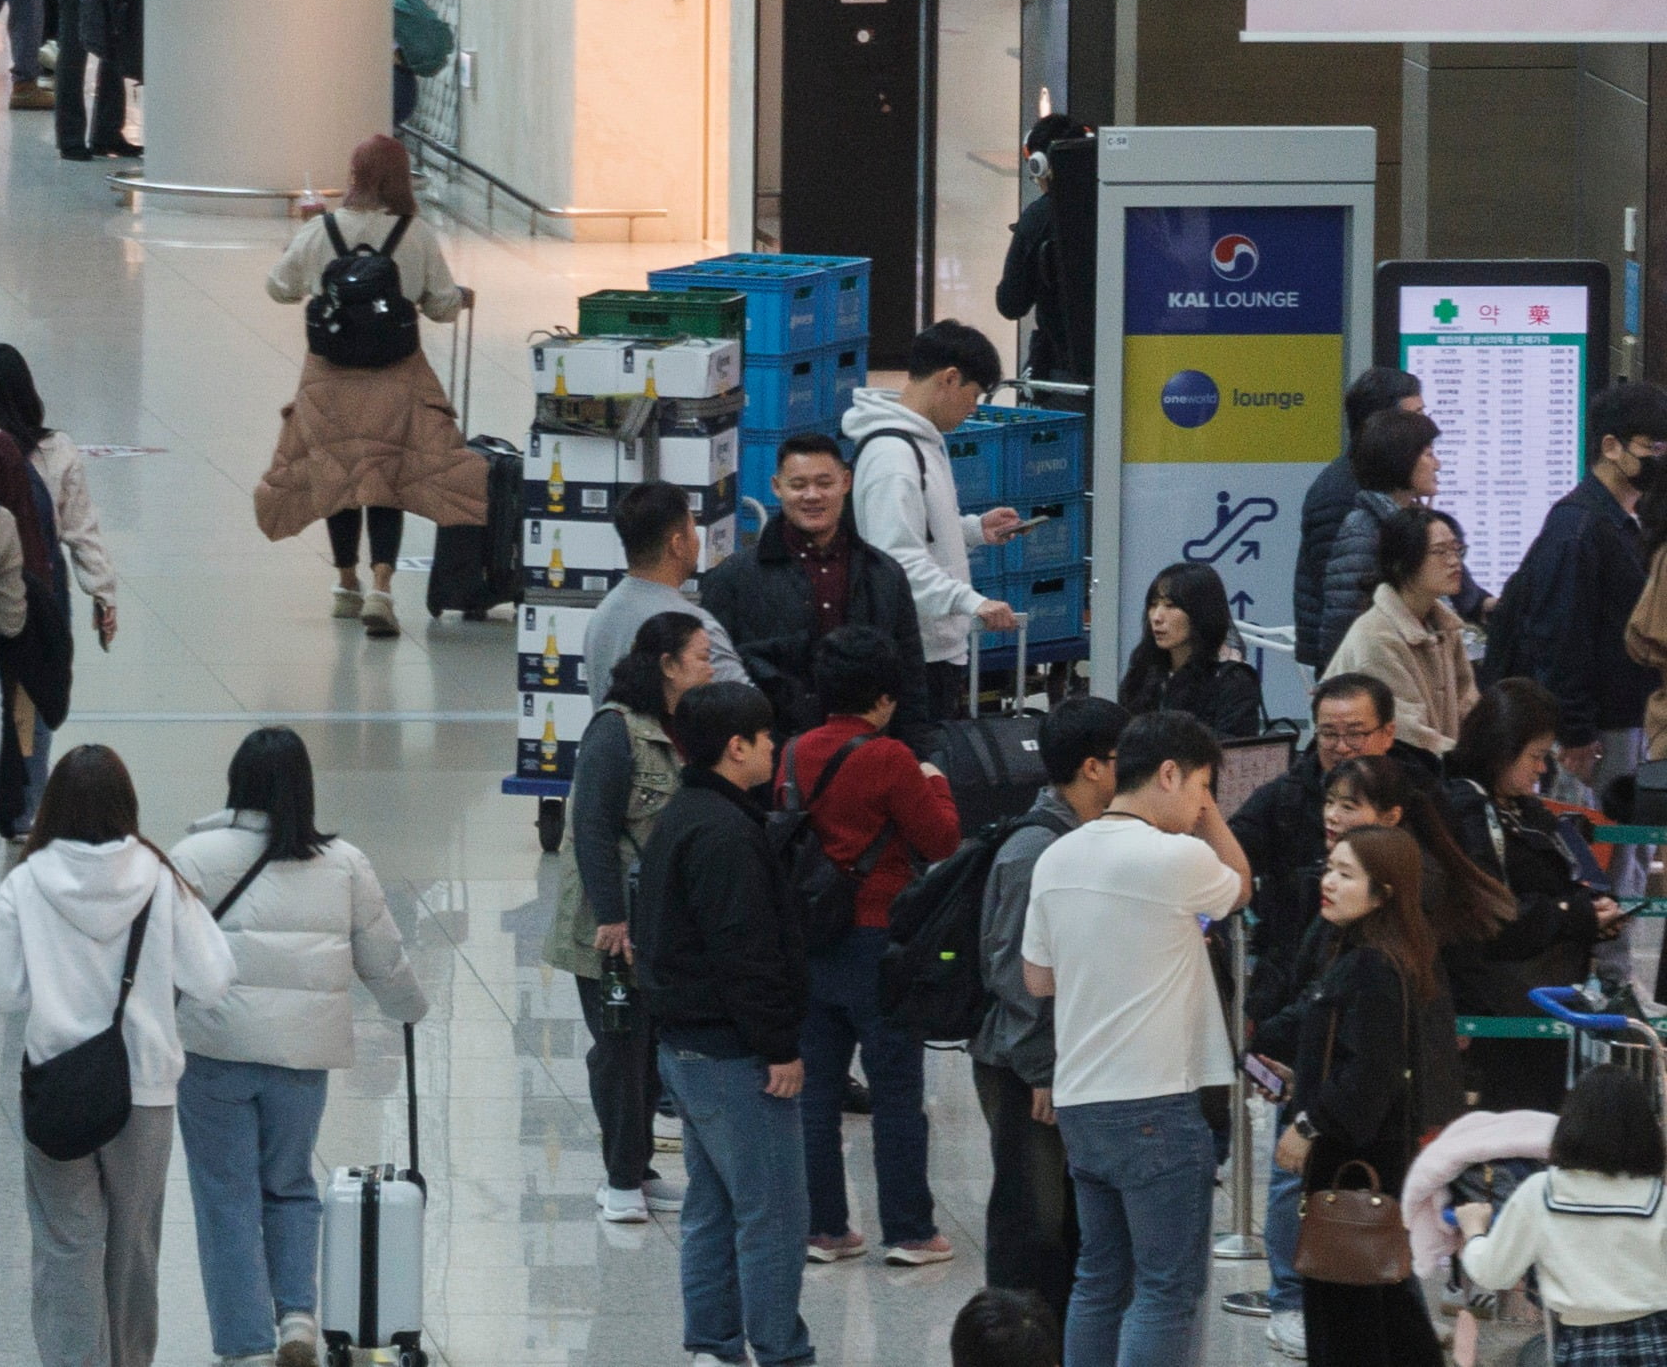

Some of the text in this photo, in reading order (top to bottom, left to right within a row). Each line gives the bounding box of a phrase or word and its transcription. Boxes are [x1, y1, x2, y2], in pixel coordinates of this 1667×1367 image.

[1167, 291, 1300, 309] KAL LOUNGE
[1479, 304, 1501, 326] 약
[1162, 393, 1218, 404] oneworld
[1233, 388, 1305, 410] lounge
